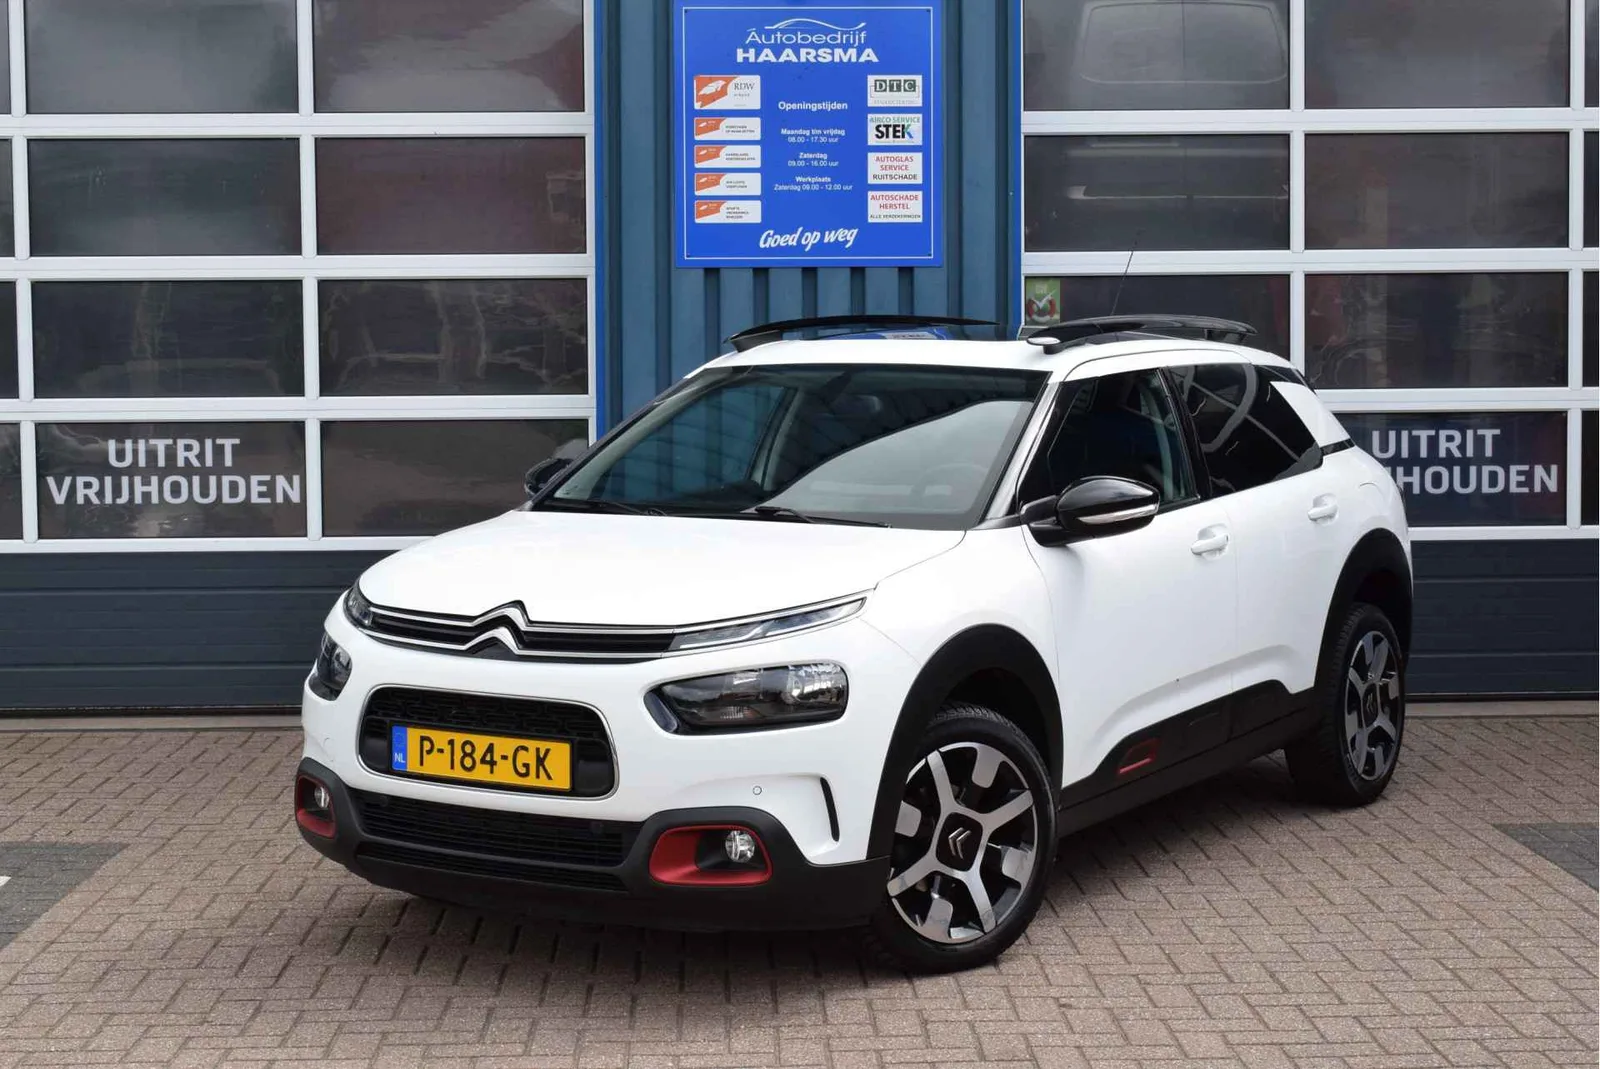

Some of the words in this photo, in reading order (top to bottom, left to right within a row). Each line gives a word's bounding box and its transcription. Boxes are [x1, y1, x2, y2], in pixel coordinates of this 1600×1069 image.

[736, 48, 879, 63] HAARSMA
[734, 82, 755, 91] RDW
[874, 79, 916, 92] DTC
[778, 101, 848, 112] Openingstijden
[780, 128, 810, 136] Maandag
[823, 128, 846, 136] vrijdag
[875, 124, 914, 139] STEK
[799, 152, 828, 160] Zaterdag
[795, 176, 832, 184] Werkplaats
[774, 184, 801, 192] Zaterdag
[759, 227, 803, 248] Goed
[801, 231, 821, 252] op
[823, 228, 859, 249] weg
[1371, 428, 1501, 459] UITRIT
[107, 438, 241, 468] UITRIT
[1385, 464, 1559, 495] HOUDEN
[46, 474, 301, 505] VRIJHOUDEN
[394, 751, 406, 763] NL
[418, 735, 554, 781] P-184-GK
